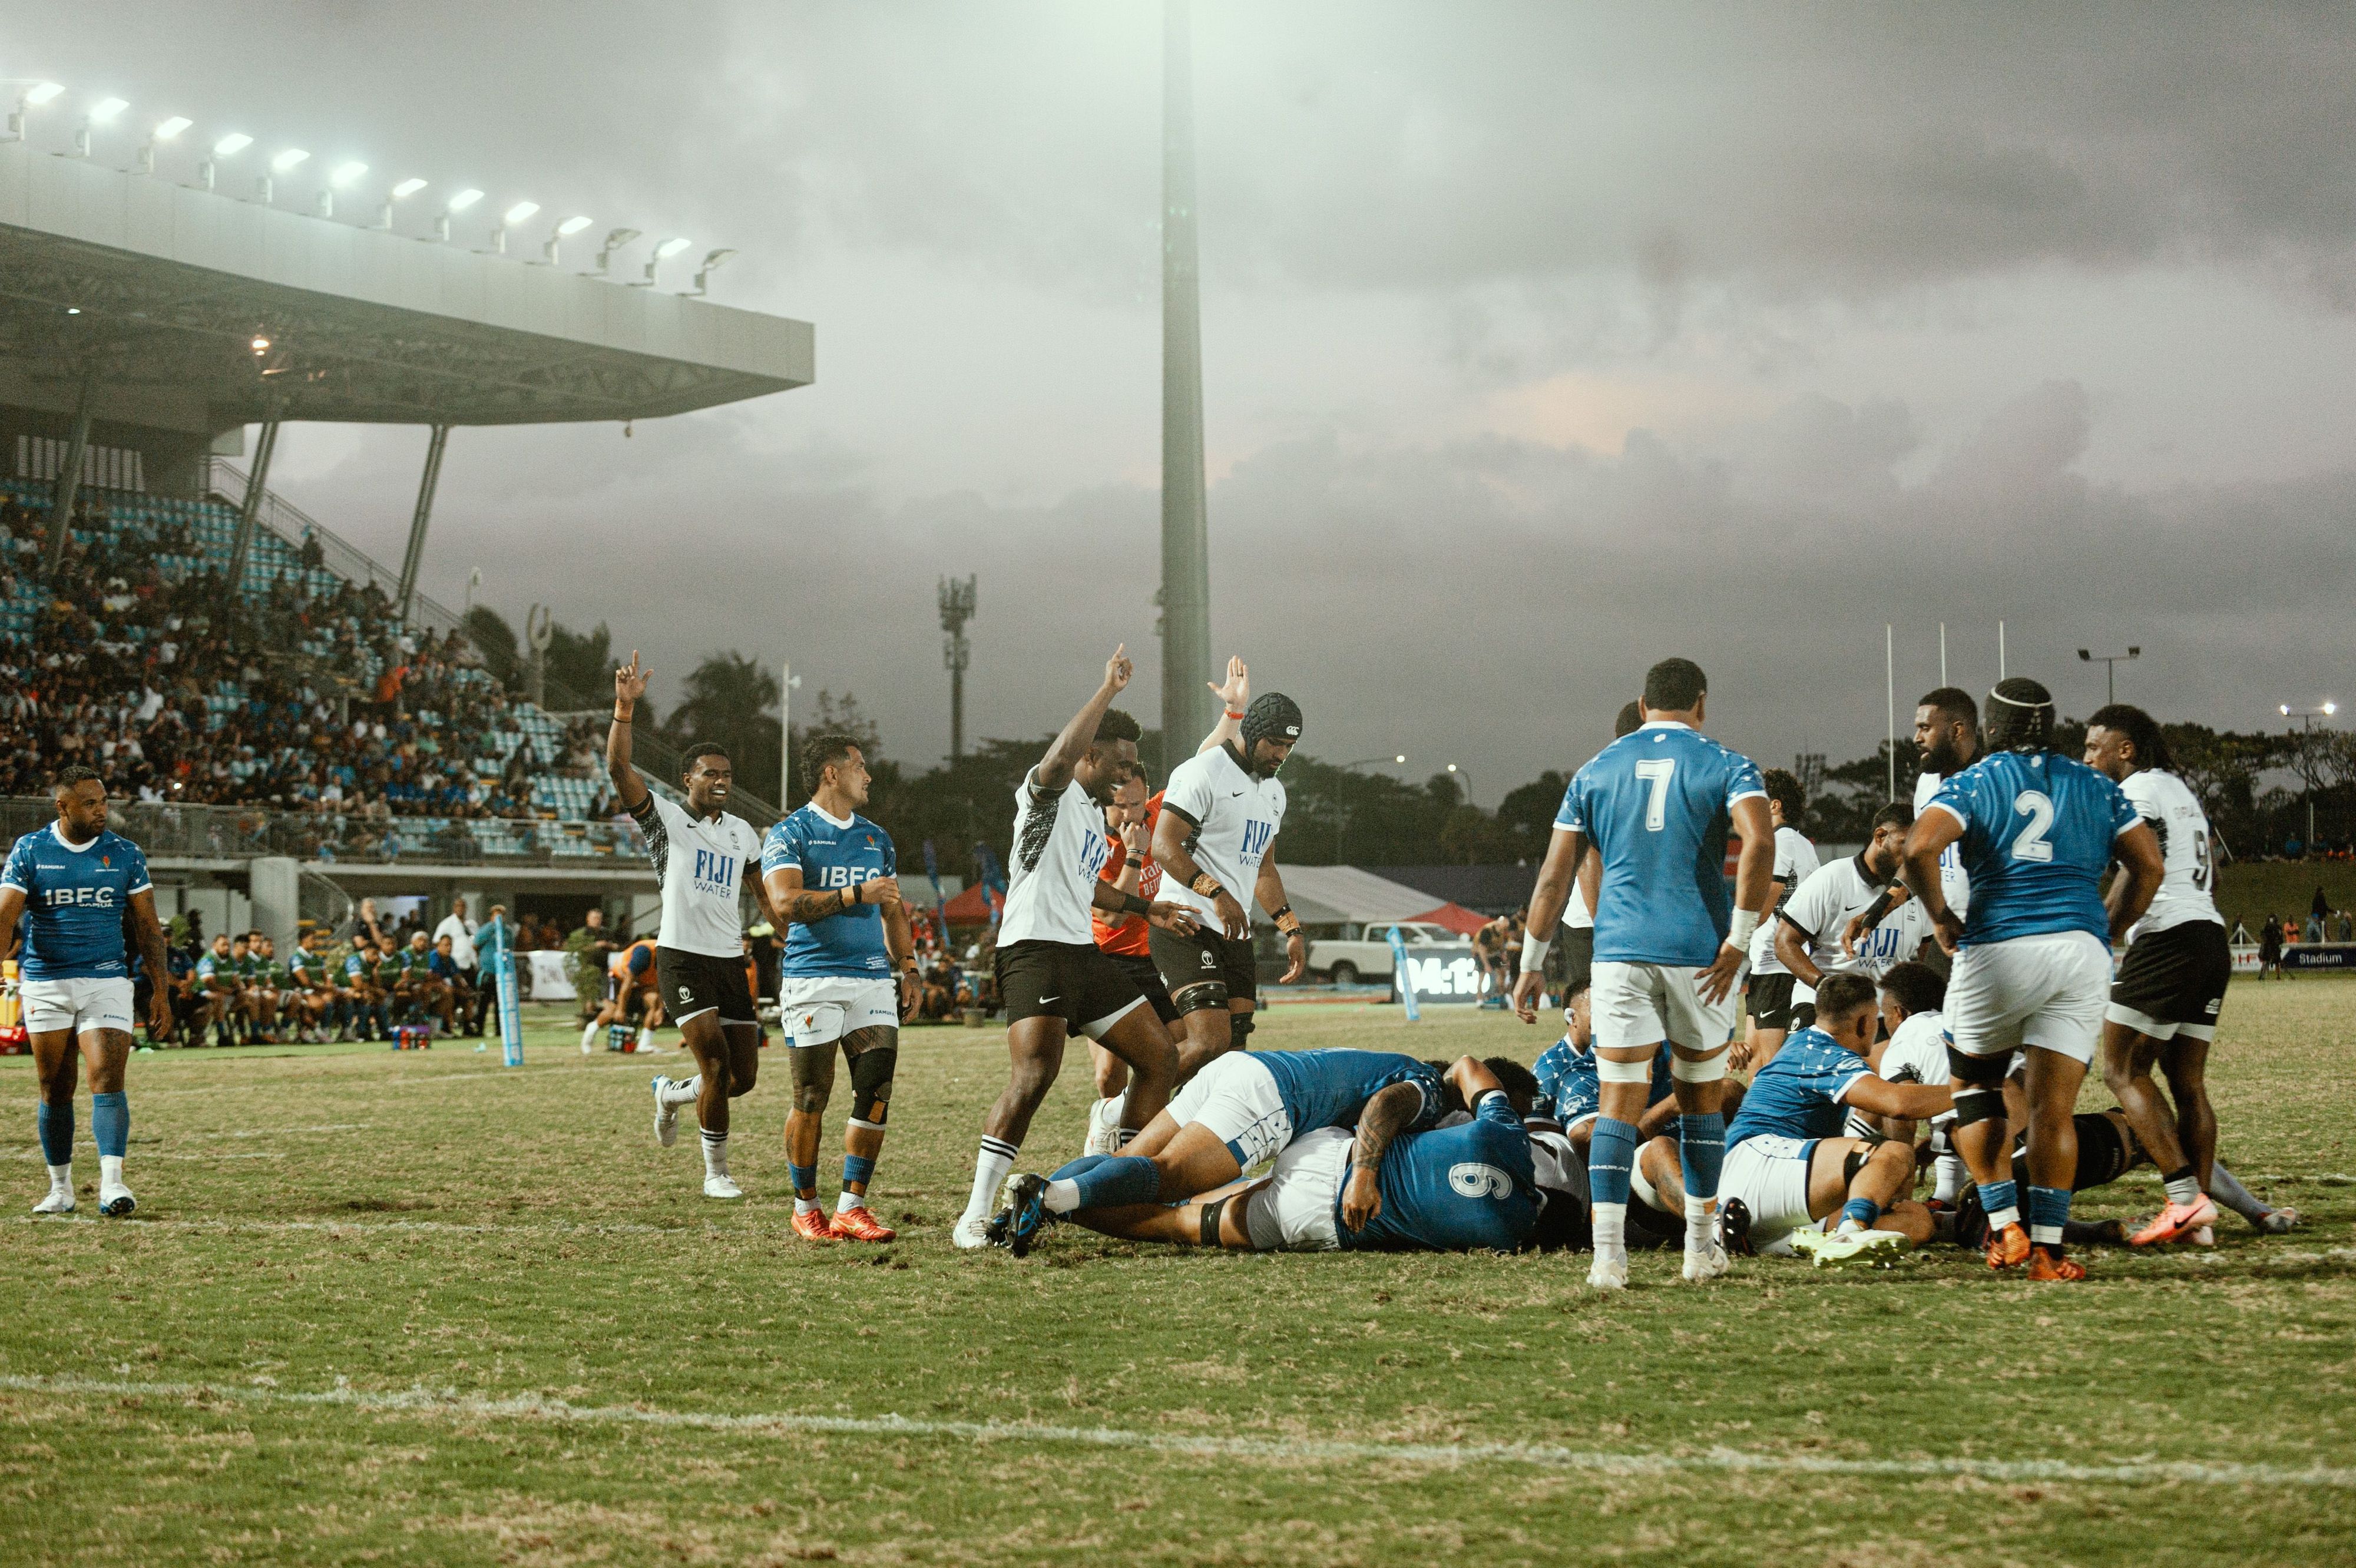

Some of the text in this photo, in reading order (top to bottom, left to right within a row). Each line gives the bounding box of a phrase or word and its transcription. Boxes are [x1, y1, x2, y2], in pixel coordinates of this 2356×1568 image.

[1635, 758, 1675, 831] 7
[1240, 819, 1271, 855] FIJI
[2011, 790, 2054, 862] 2
[694, 849, 734, 887] FIJI
[1140, 860, 1163, 882] rat
[1240, 854, 1262, 868] WATE
[2192, 831, 2208, 891] 9
[46, 886, 114, 906] IBFC
[694, 880, 732, 899] WATER
[2299, 952, 2342, 964] Stadium
